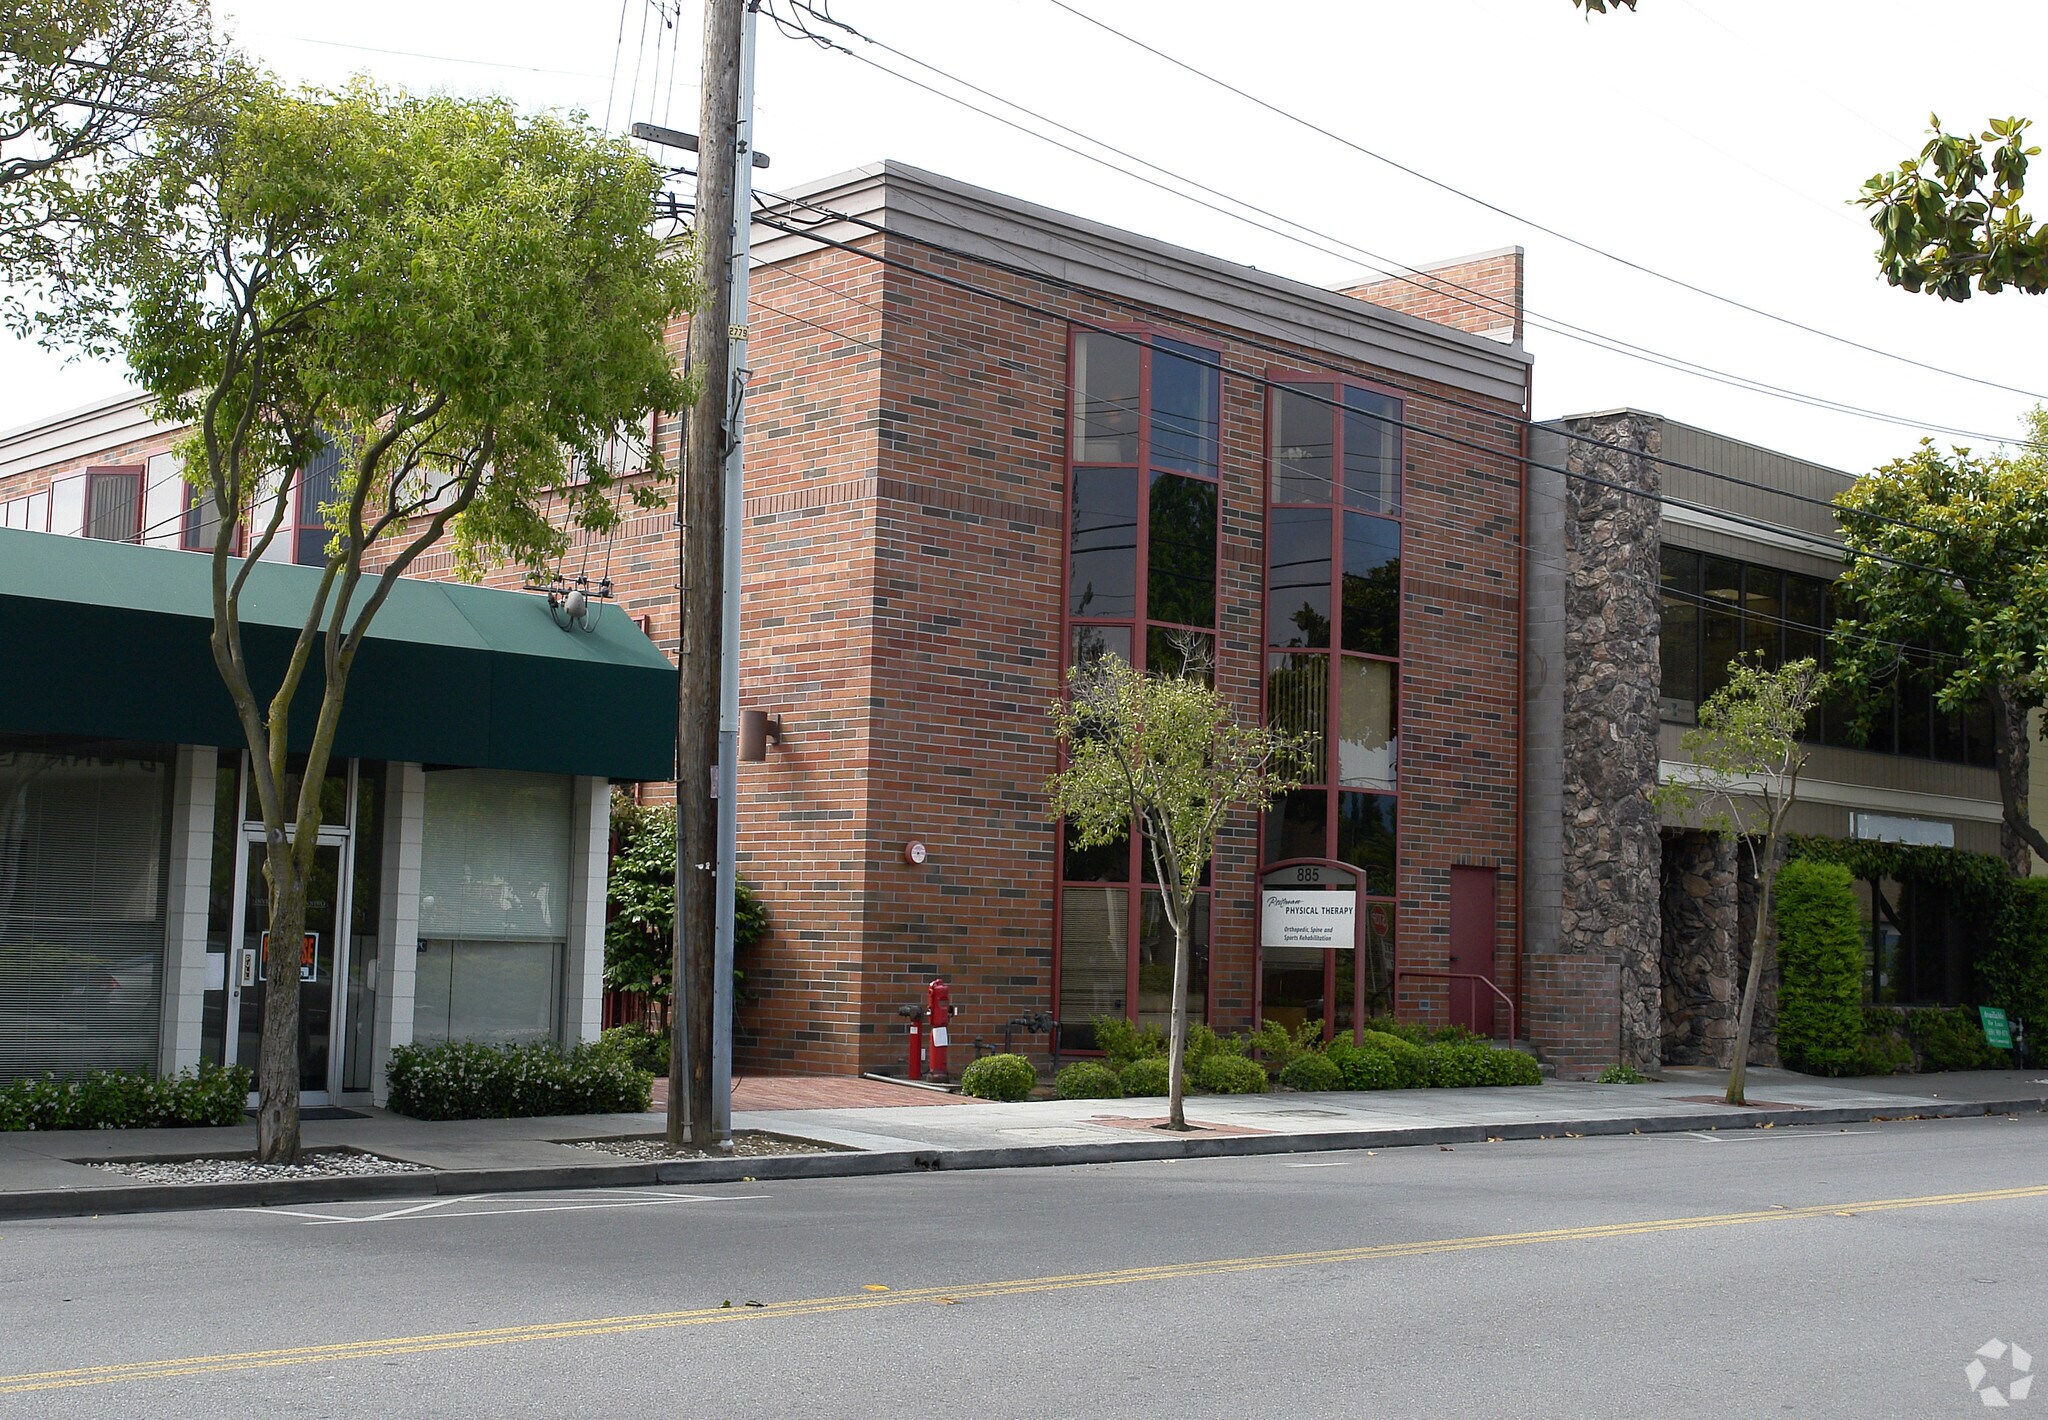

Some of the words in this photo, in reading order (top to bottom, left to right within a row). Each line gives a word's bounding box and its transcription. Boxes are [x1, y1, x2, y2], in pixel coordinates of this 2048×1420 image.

[729, 327, 747, 337] 2779
[1297, 868, 1319, 881] 885
[1285, 907, 1319, 915] PHYSICAL
[1321, 907, 1353, 915] THERAPY
